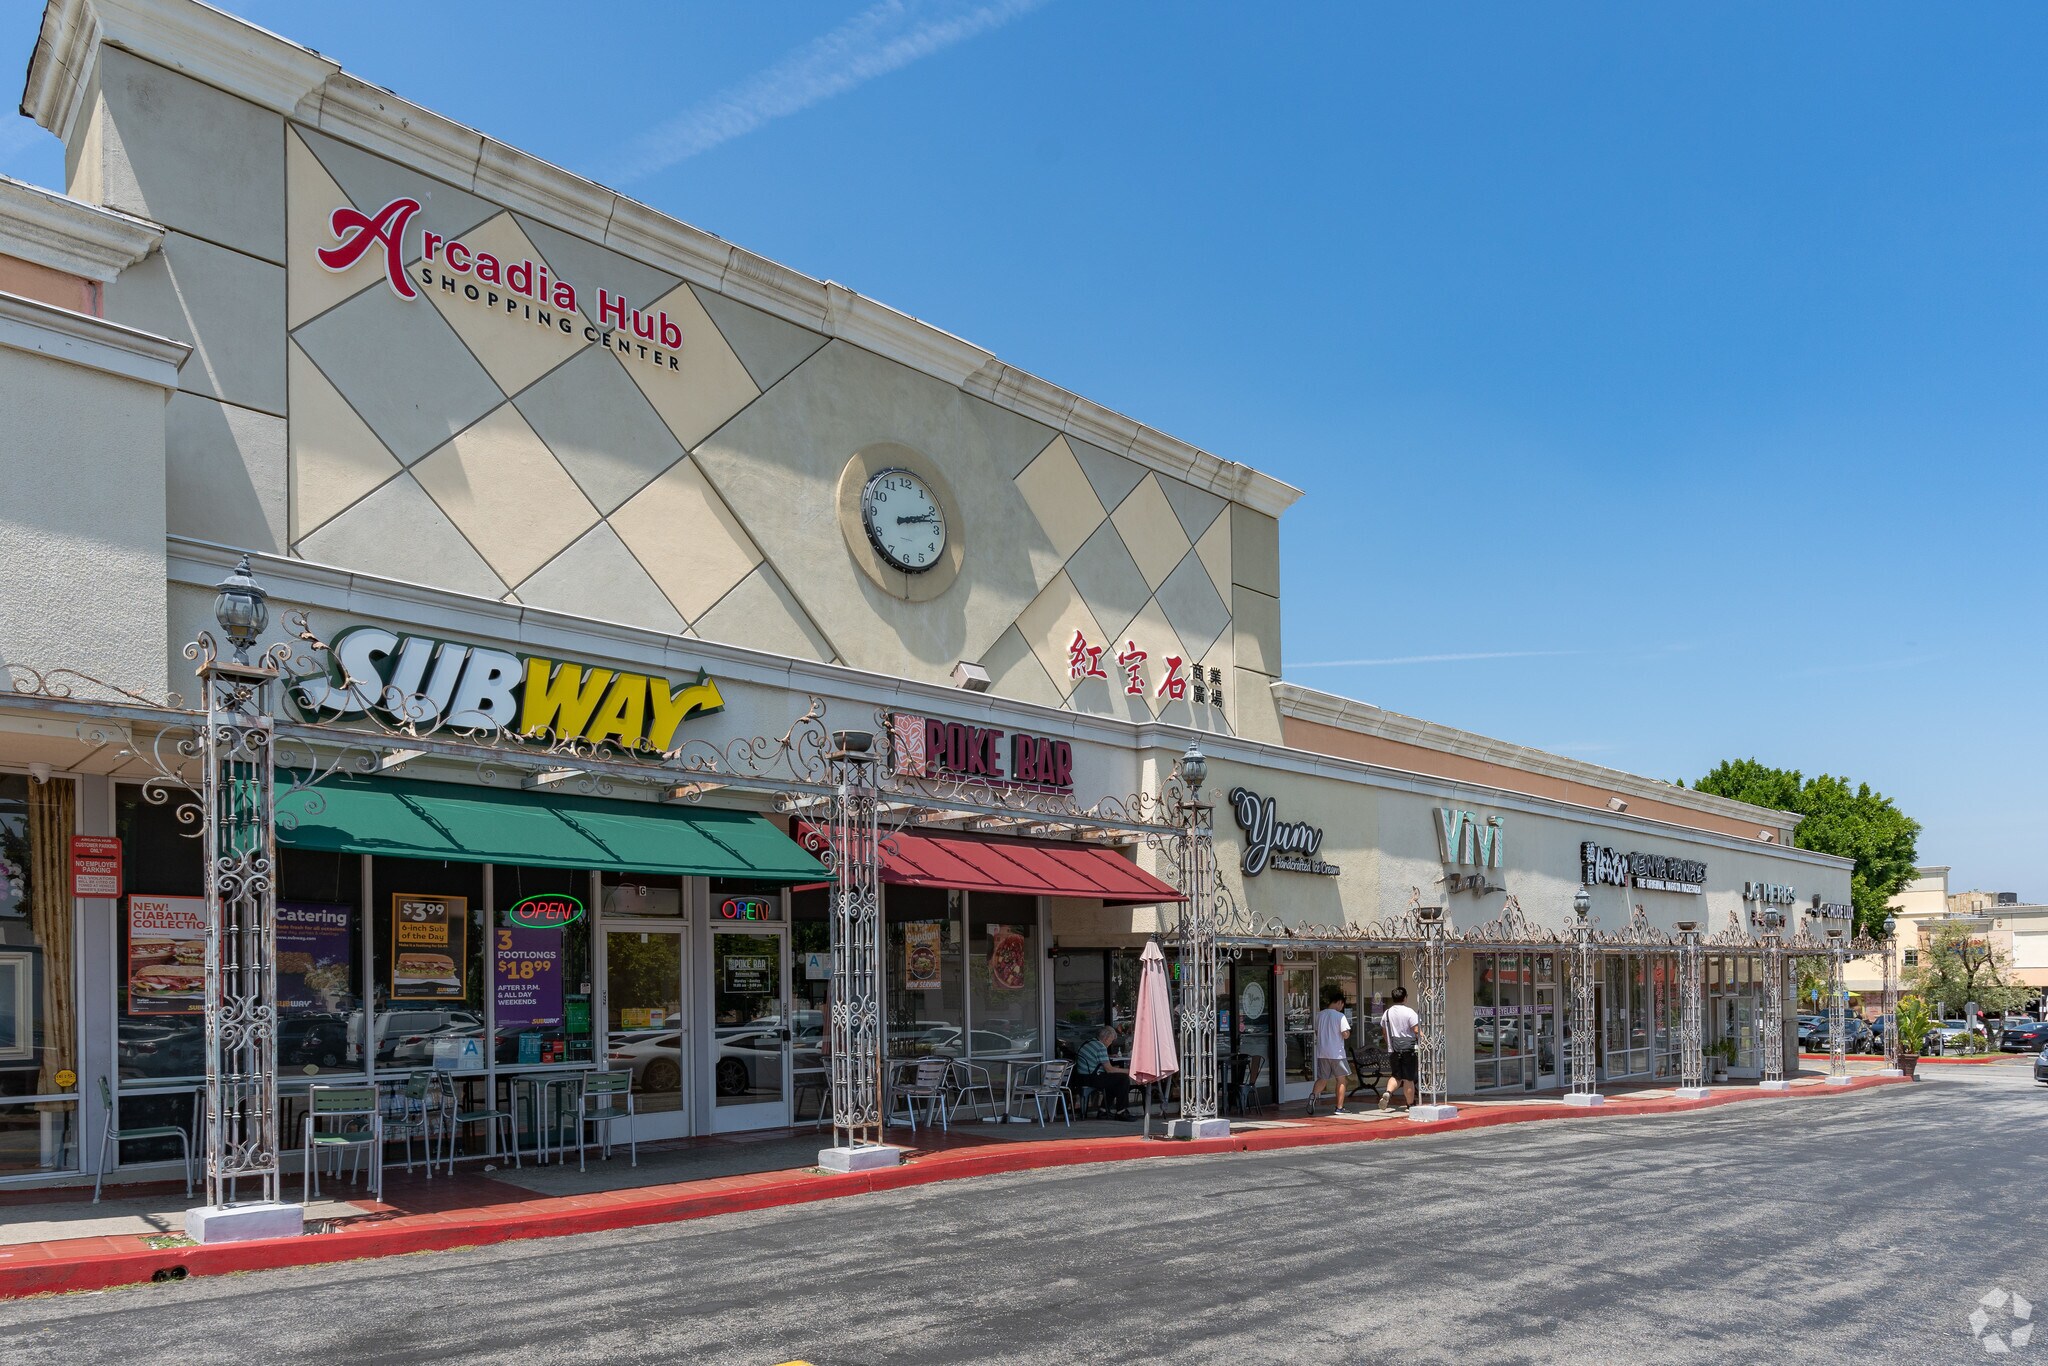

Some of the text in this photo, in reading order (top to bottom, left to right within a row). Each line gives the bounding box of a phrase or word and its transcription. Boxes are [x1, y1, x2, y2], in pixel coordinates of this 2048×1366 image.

[316, 197, 684, 350] Arcadia Hub
[421, 268, 681, 372] SHOPPING CENTER
[885, 480, 896, 491] 11
[899, 478, 913, 490] 12
[874, 491, 887, 502] 10
[919, 490, 925, 499] 1
[870, 506, 878, 516] 9
[928, 506, 936, 516] 2
[875, 526, 883, 537] 8
[933, 525, 940, 536] 3
[888, 544, 895, 554] 7
[928, 542, 935, 552] 4
[902, 554, 910, 564] 6
[918, 553, 925, 563] 5
[1068, 629, 1188, 700] 紅宝石
[1190, 663, 1222, 687] 商業
[288, 627, 725, 753] SUBWAY
[926, 719, 1074, 786] POKE BAR
[1229, 786, 1323, 877] Yum
[82, 866, 111, 874] PARKING
[1637, 877, 1646, 888] THE
[640, 887, 646, 896] G
[1744, 881, 1760, 901] JC
[133, 902, 169, 911] NEW!
[520, 901, 573, 920] OPEN
[722, 900, 769, 920] OPEN
[133, 911, 198, 920] CIABATTA
[276, 907, 347, 926] Catering
[133, 919, 207, 929] COLLECTIO
[401, 924, 427, 932] 6-inch
[412, 932, 426, 940] the
[428, 933, 444, 941] Day
[497, 930, 513, 950] 3
[498, 951, 557, 959] FOOTLONGS
[809, 954, 820, 967] A
[735, 959, 766, 969] POKE BAR
[1474, 1007, 1494, 1016] WAXING
[464, 1039, 479, 1056] A
